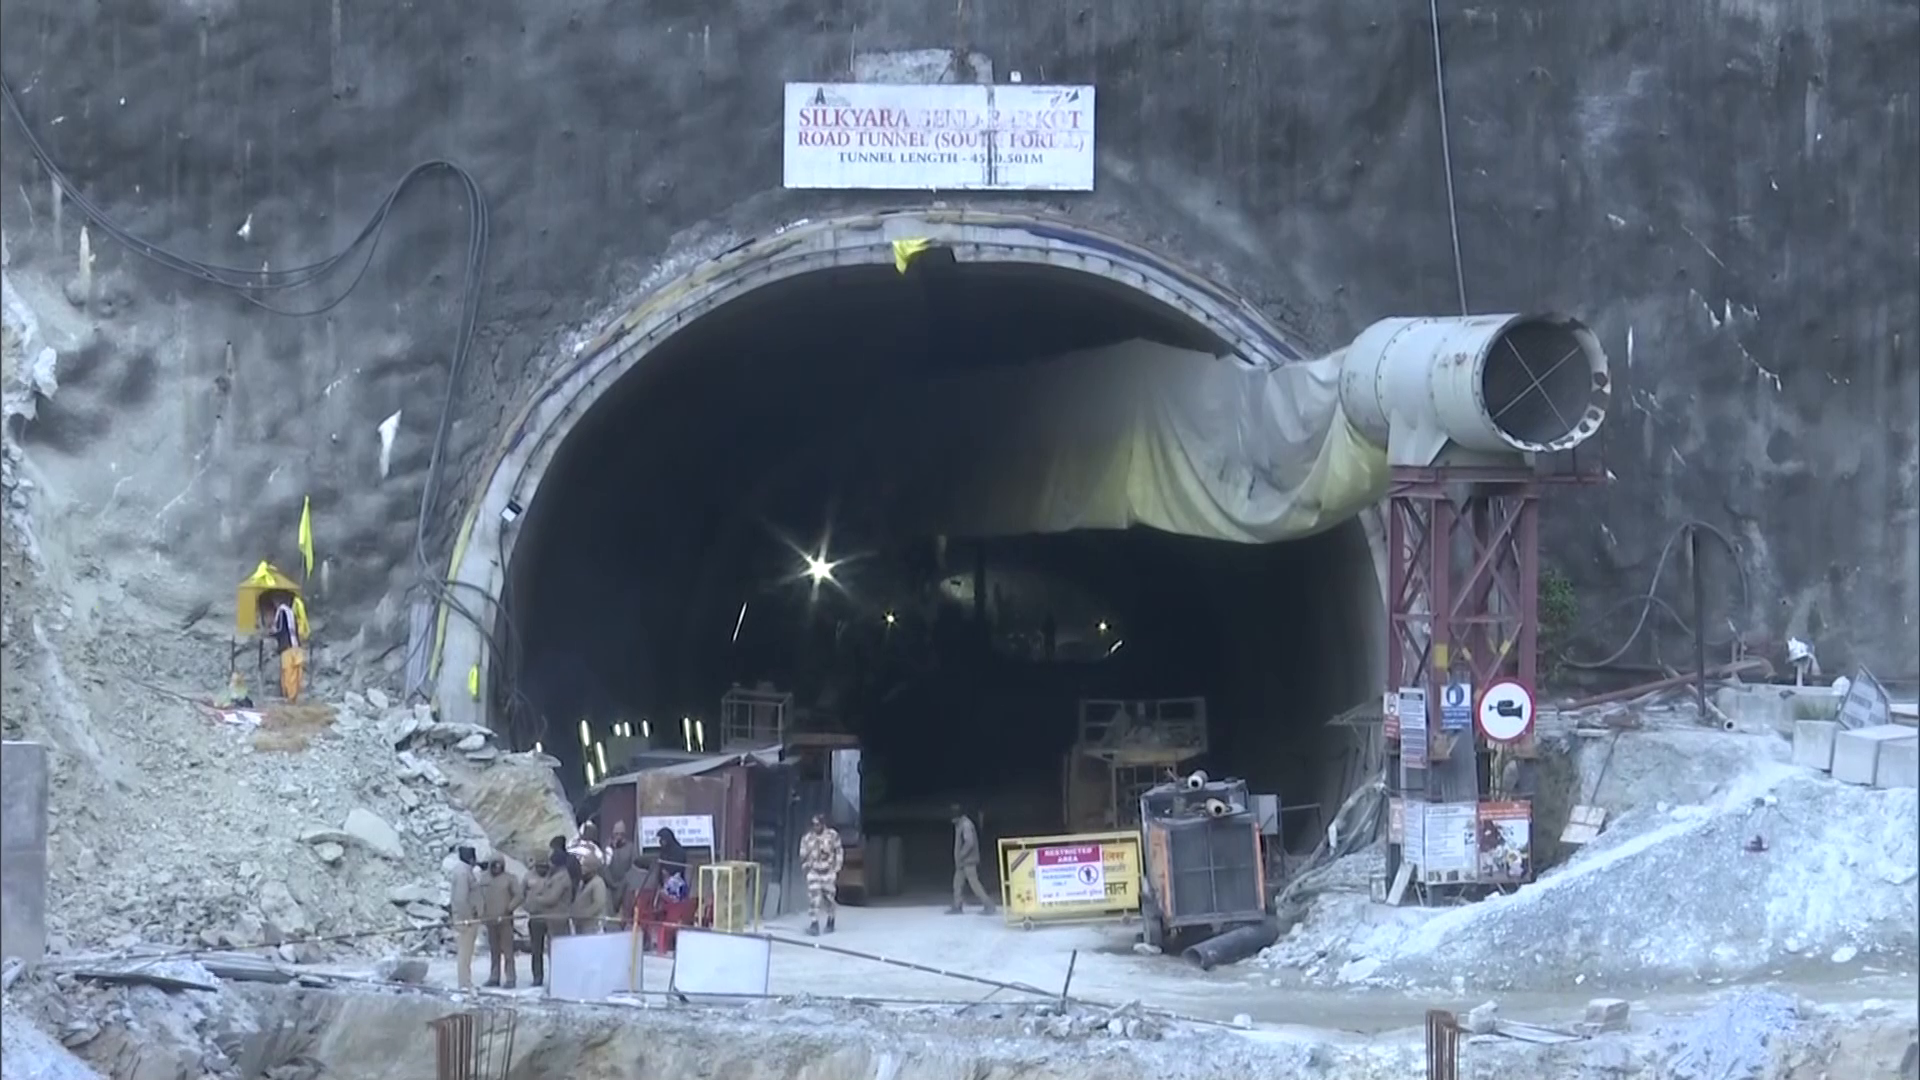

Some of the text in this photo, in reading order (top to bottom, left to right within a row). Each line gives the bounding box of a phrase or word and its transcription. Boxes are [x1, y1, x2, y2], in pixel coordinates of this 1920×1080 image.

[799, 108, 910, 128] SILKYARA
[798, 131, 851, 147] ROAD
[858, 131, 929, 147] TUNNEL
[934, 131, 1004, 151] (SOUT
[839, 152, 895, 163] TUNNEL
[900, 152, 958, 164] LENGTH
[969, 153, 1044, 165] 450.501M
[1044, 847, 1093, 857] RESTRICTED
[1057, 855, 1079, 863] AREA
